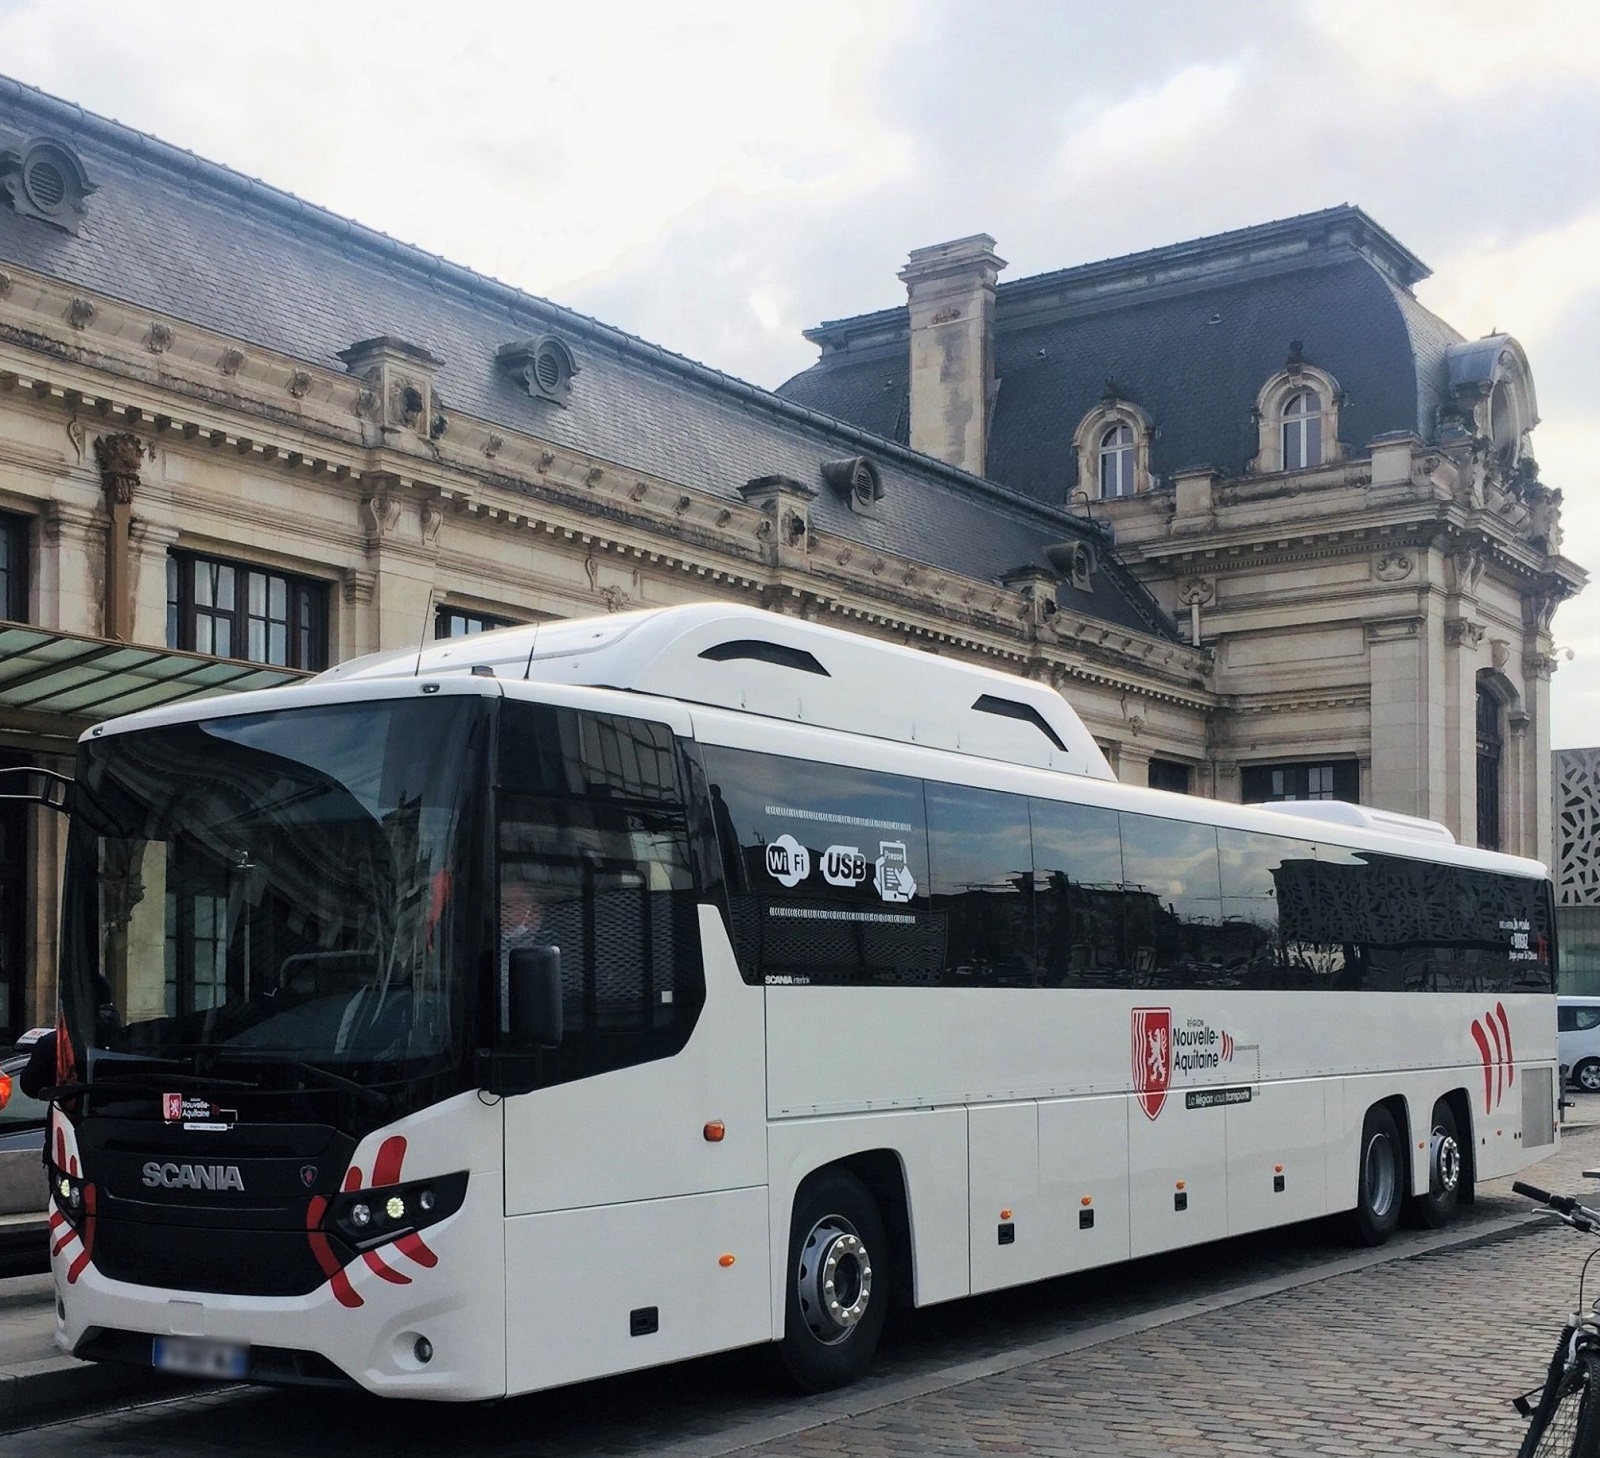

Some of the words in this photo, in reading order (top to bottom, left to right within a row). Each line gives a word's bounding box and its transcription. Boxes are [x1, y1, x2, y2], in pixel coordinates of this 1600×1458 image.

[884, 850, 903, 861] Presse
[827, 852, 865, 879] USB
[765, 975, 793, 985] SCANIA
[1173, 1026, 1219, 1047] Nouvelle-
[1173, 1049, 1219, 1076] Aquitaine
[1195, 1093, 1213, 1107] Région
[182, 1108, 210, 1120] Aquitaine
[142, 1162, 245, 1191] SCANIA
